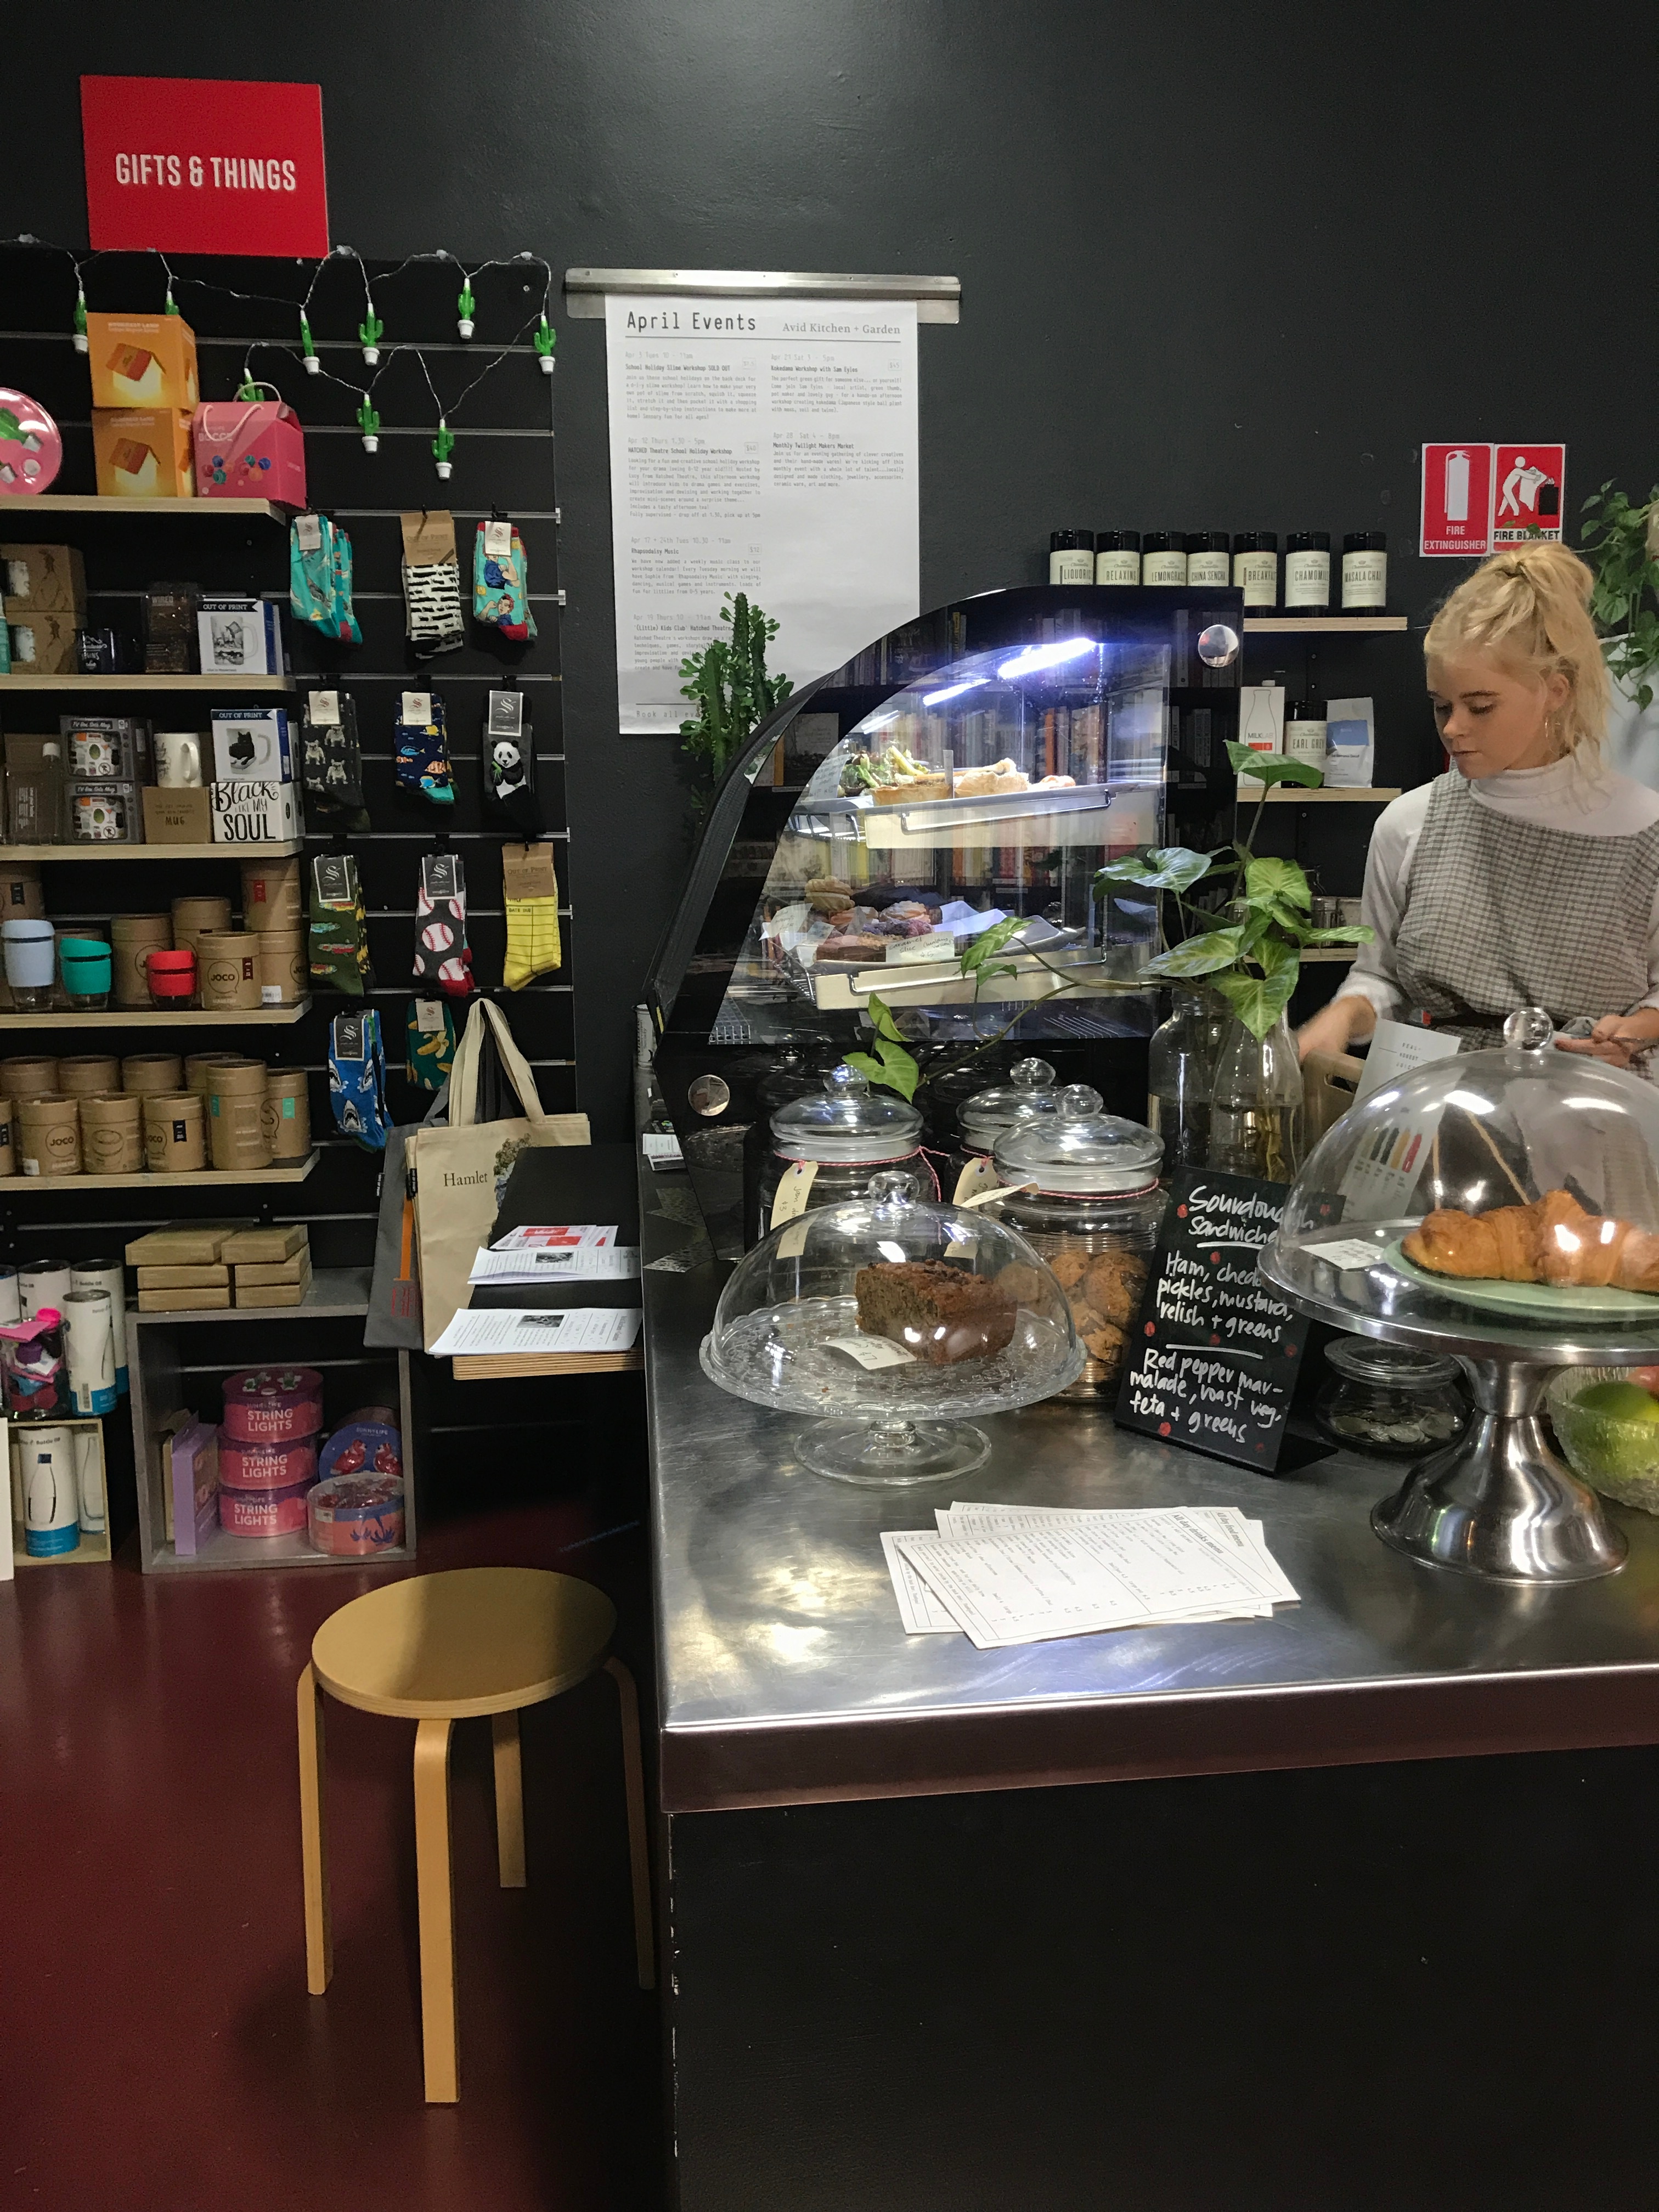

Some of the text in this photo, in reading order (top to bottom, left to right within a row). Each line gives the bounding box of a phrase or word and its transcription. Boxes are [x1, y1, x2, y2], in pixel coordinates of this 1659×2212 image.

[116, 153, 296, 191] GIFTS & THINGS
[627, 312, 756, 332] April Events
[782, 322, 806, 332] Avid
[810, 323, 850, 333] Kitchen
[862, 324, 900, 334] Garden
[1446, 526, 1465, 535] FIRE
[1494, 531, 1514, 540] FIRE
[1424, 540, 1486, 550] EXTINGUISHER
[1107, 571, 1136, 581] RELAXING
[1192, 571, 1206, 582] CHINA
[1368, 570, 1381, 582] CHAI
[1293, 739, 1308, 749] EARL
[212, 782, 279, 812] Black
[253, 798, 268, 812] MY
[165, 816, 185, 825] MUG
[223, 814, 276, 840] SOUL
[50, 1136, 74, 1146] JOCO
[443, 1170, 488, 1187] Hamlet
[1166, 1250, 1210, 1283] Ham,
[1160, 1301, 1282, 1343] relish + greens
[1143, 1348, 1177, 1374] Red
[1179, 1357, 1234, 1384] pepper
[1200, 1384, 1244, 1410] roast
[247, 1409, 293, 1421] STRING
[1130, 1390, 1247, 1443] feta + greens
[248, 1420, 292, 1432] LIGHTS
[242, 1454, 287, 1466] STRING
[242, 1465, 287, 1477] LIGHTS
[234, 1504, 278, 1515] STRING
[234, 1514, 277, 1525] LIGHTS
[1225, 1525, 1238, 1533] food
[1179, 1518, 1190, 1530] day
[1189, 1528, 1208, 1542] drinks
[1206, 1541, 1224, 1554] menu
[1231, 1534, 1244, 1547] menu
